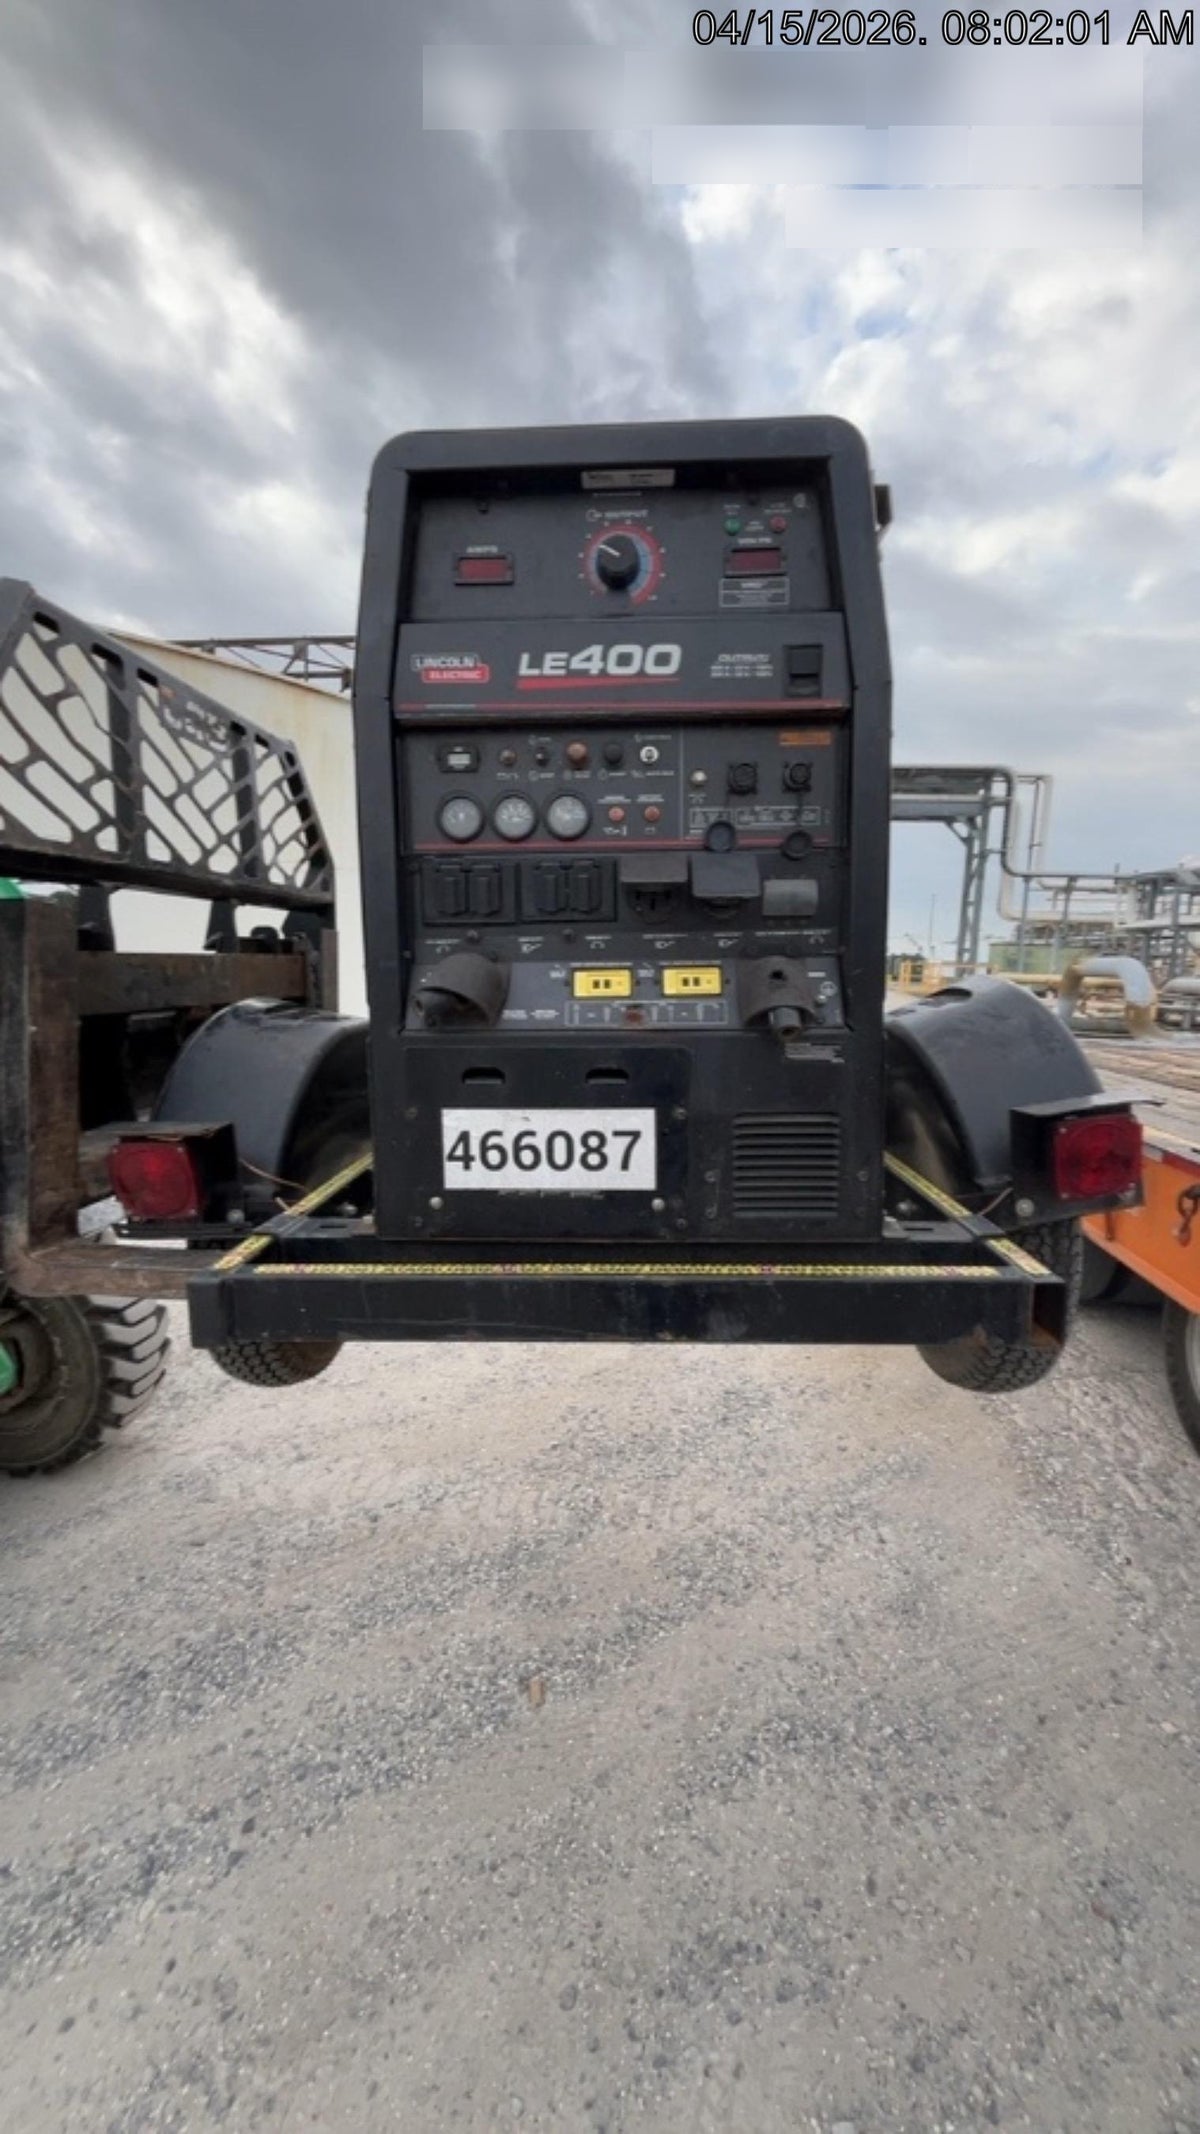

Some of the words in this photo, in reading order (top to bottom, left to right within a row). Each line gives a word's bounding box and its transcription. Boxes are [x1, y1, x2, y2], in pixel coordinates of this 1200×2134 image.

[413, 655, 476, 668] LINCOLN
[518, 643, 682, 677] LE400
[445, 1129, 642, 1172] 466087
